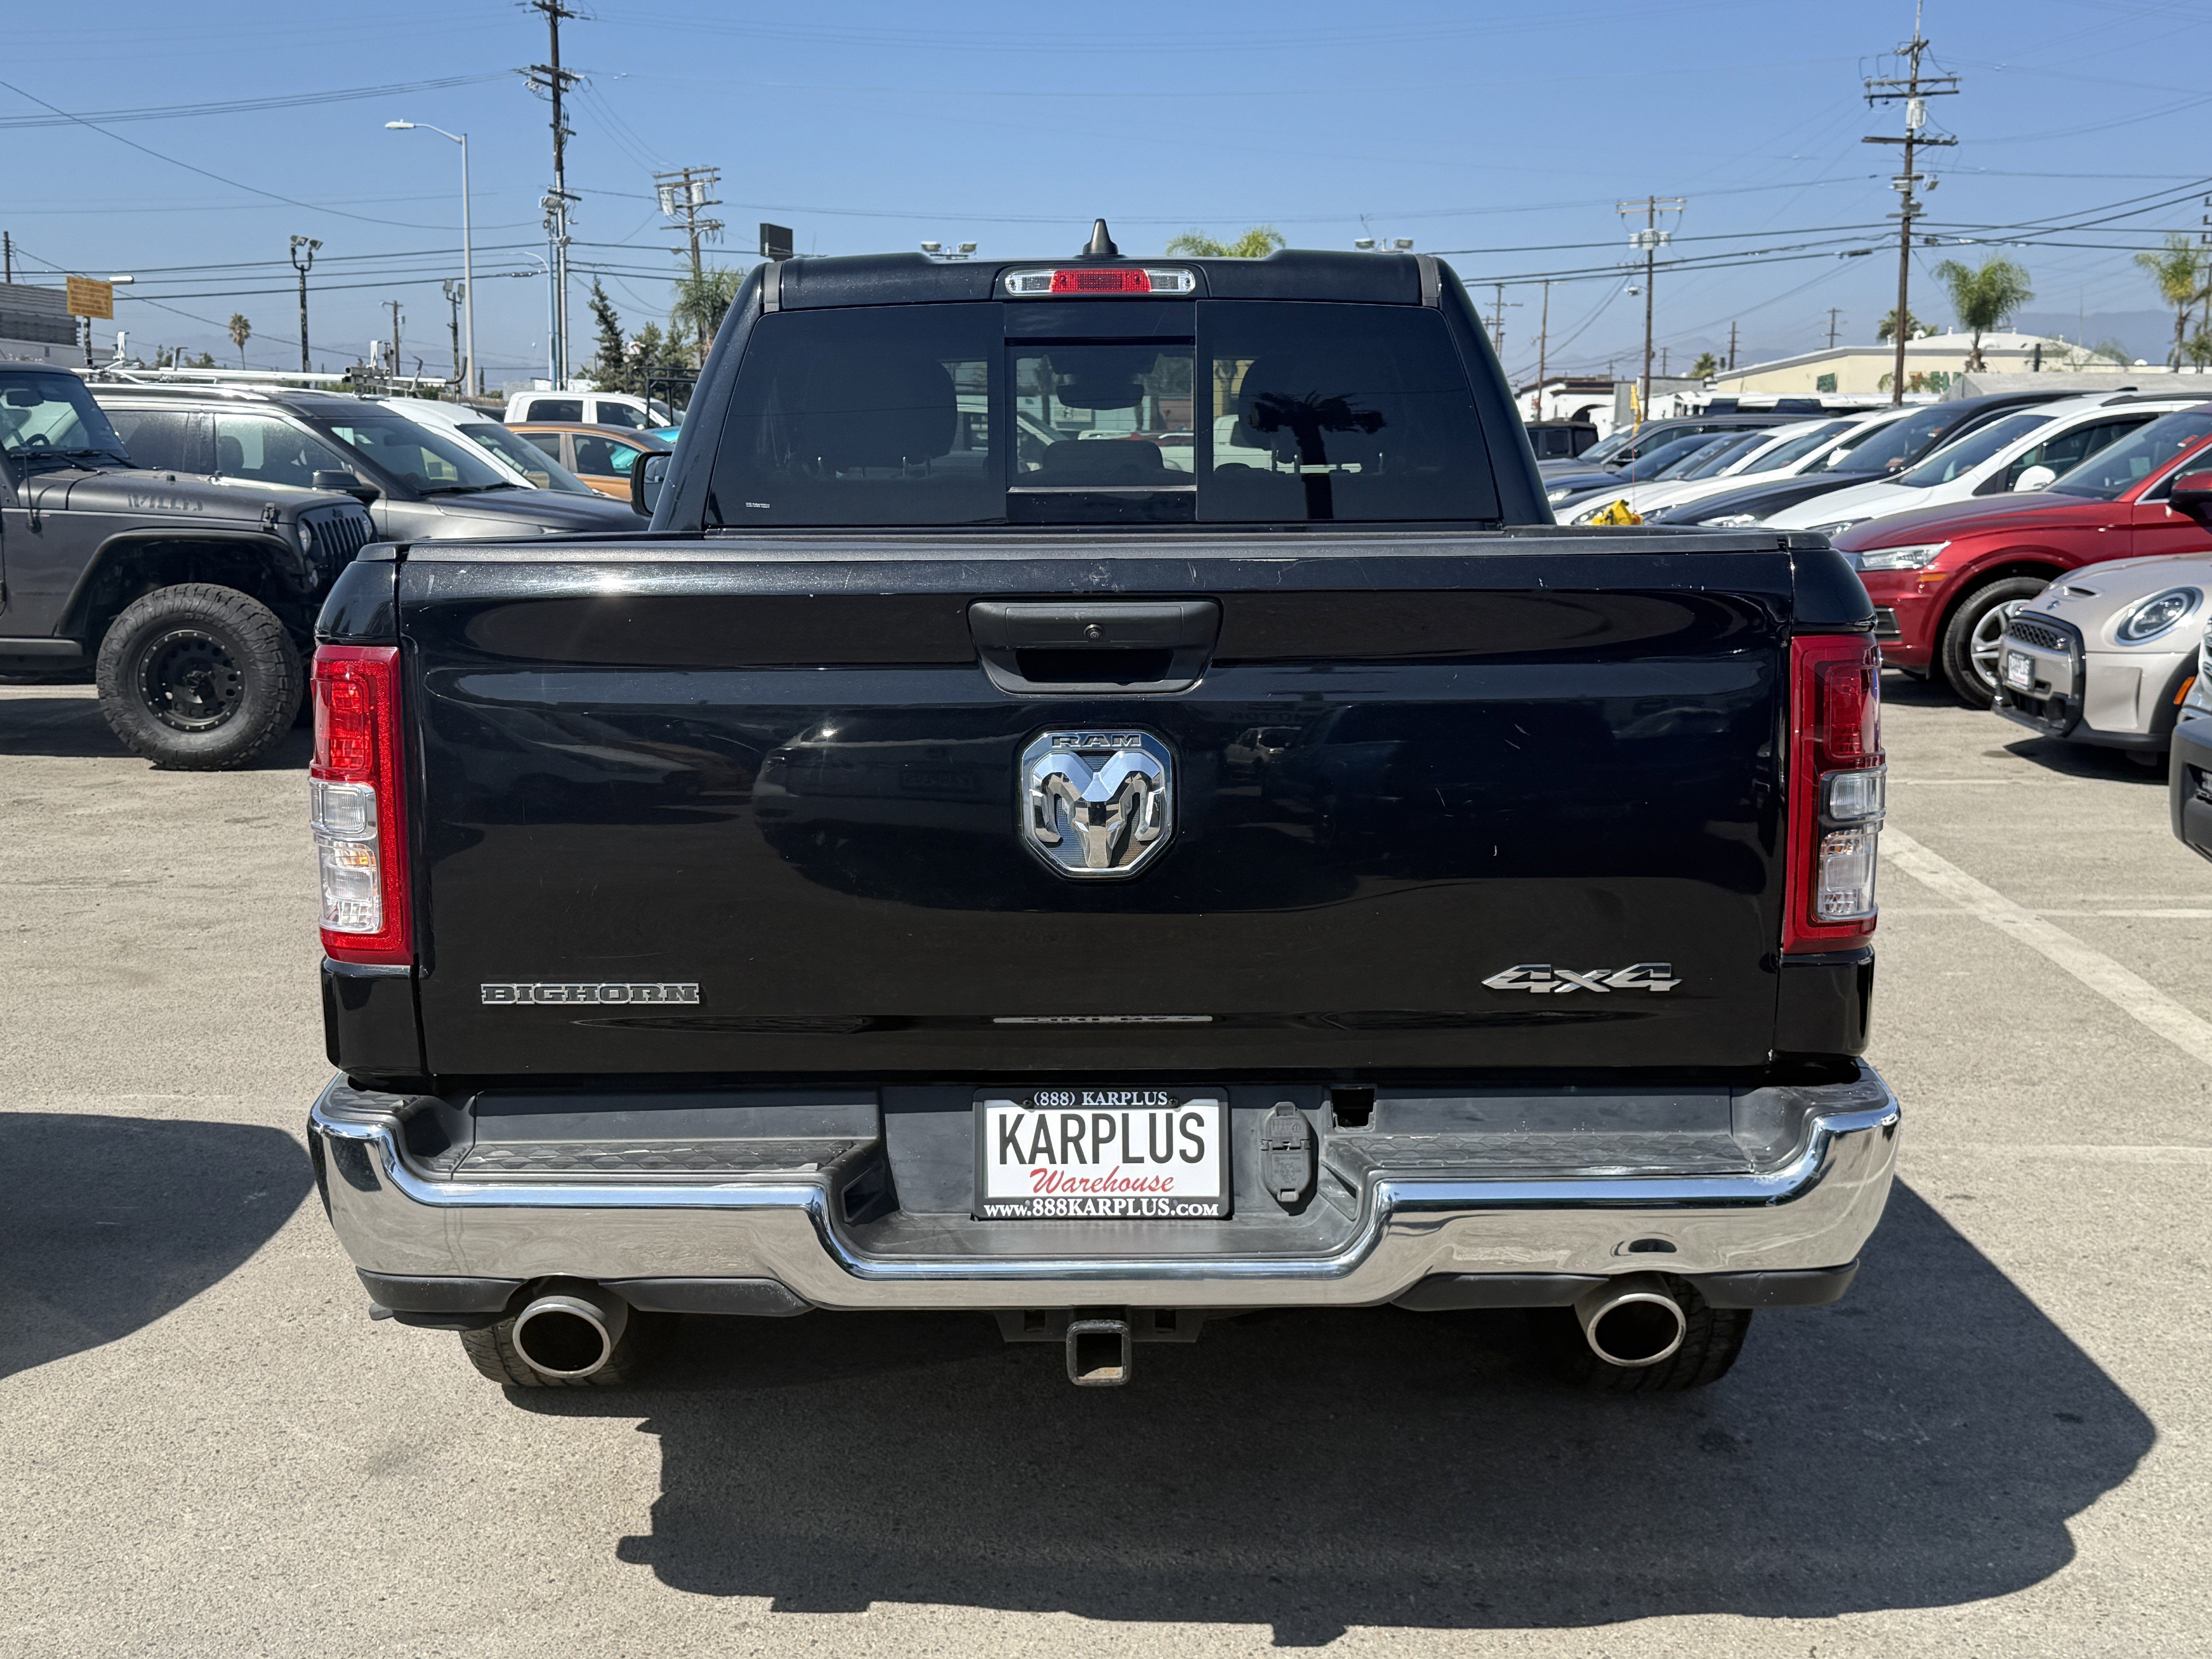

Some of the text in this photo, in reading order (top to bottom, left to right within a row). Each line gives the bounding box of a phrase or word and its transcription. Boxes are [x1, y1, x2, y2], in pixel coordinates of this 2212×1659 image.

[1051, 733, 1142, 747] RAM
[481, 982, 700, 1005] BIGHORN
[1034, 1091, 1168, 1106] (888) KARPLUS
[999, 1112, 1205, 1165] KARPLUS
[1029, 1166, 1175, 1194] Warehouse
